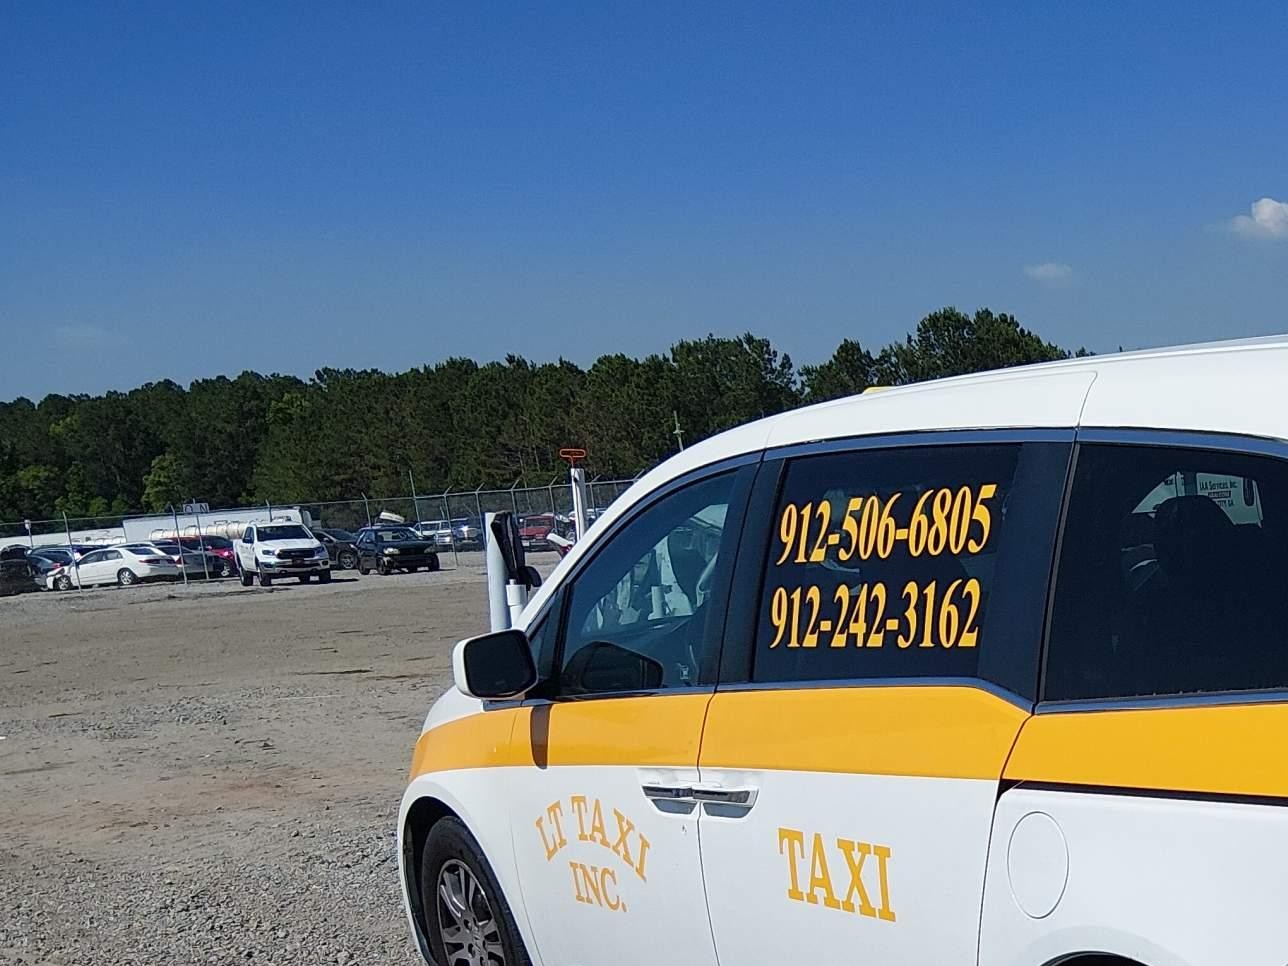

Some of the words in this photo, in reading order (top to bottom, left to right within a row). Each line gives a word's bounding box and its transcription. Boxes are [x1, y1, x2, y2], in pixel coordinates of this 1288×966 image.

[776, 484, 998, 565] 912-506-6805
[769, 578, 981, 649] 912-242-3162
[535, 801, 567, 861] LT
[571, 795, 651, 883] TAXI
[778, 827, 896, 922] TAXI
[569, 861, 628, 913] INC.
